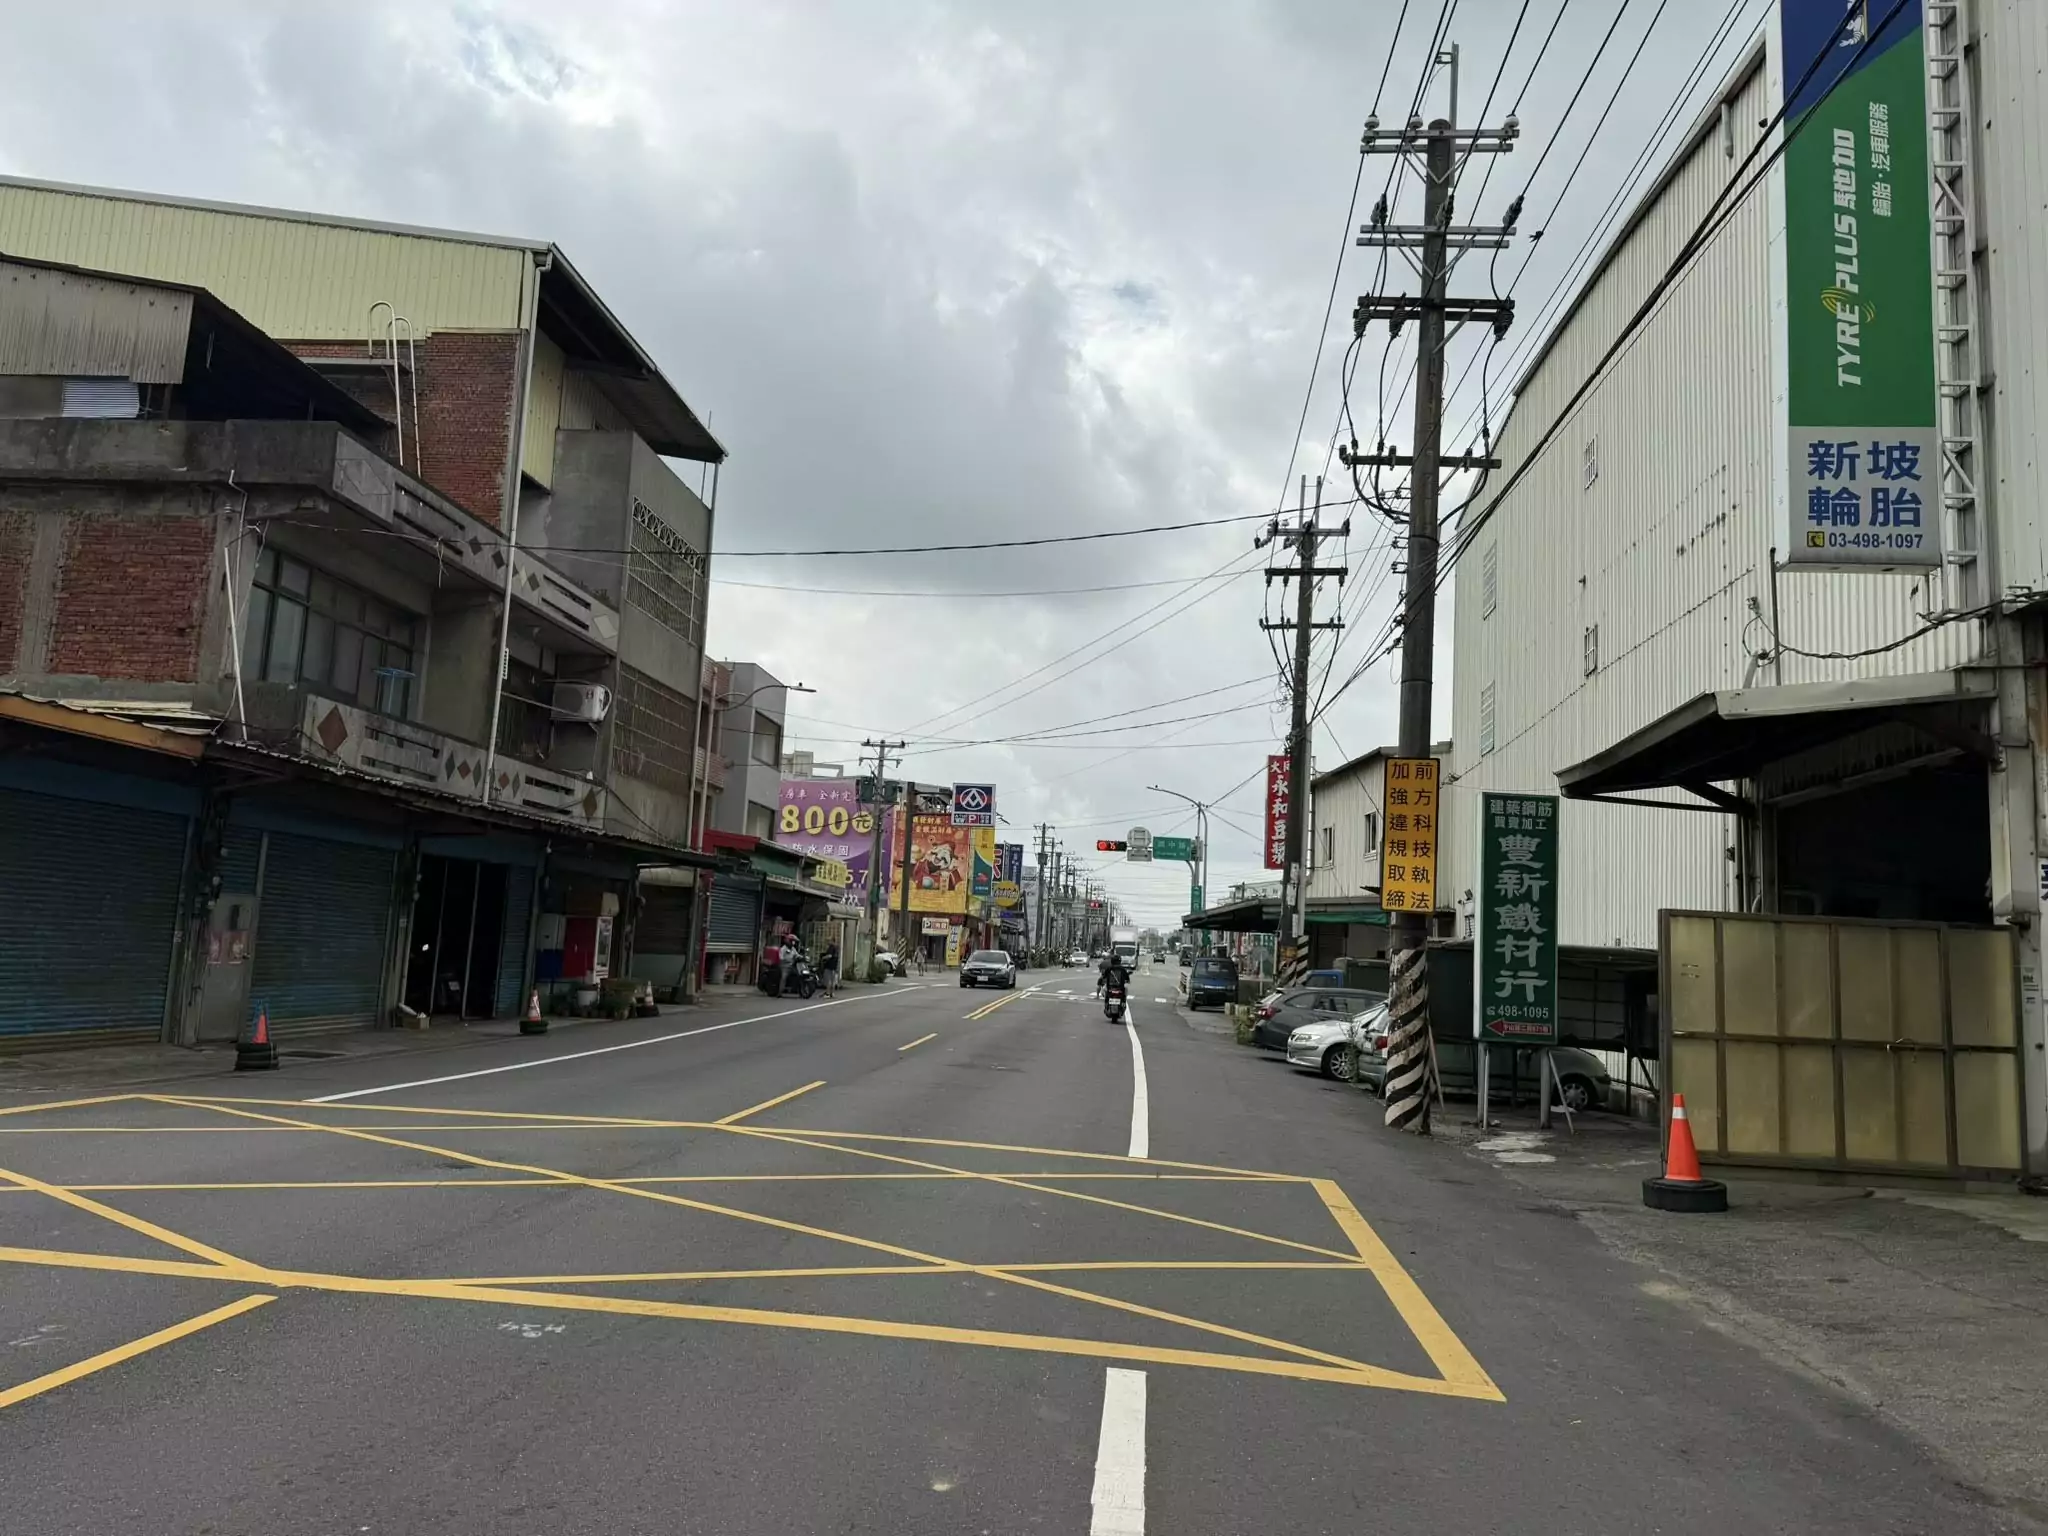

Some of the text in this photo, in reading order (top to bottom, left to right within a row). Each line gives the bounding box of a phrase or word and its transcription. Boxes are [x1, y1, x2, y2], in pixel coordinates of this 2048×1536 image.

[1832, 128, 1856, 210] 馳加
[1807, 440, 1922, 481] 新坡
[1808, 486, 1923, 527] 輪胎
[1828, 532, 1923, 548] 03-498-1097
[1490, 800, 1553, 818] 建築鋼筋
[1386, 762, 1410, 909] 加強違規取締
[1410, 762, 1434, 910] 前方科技執法
[1498, 1005, 1549, 1018] 498-1095
